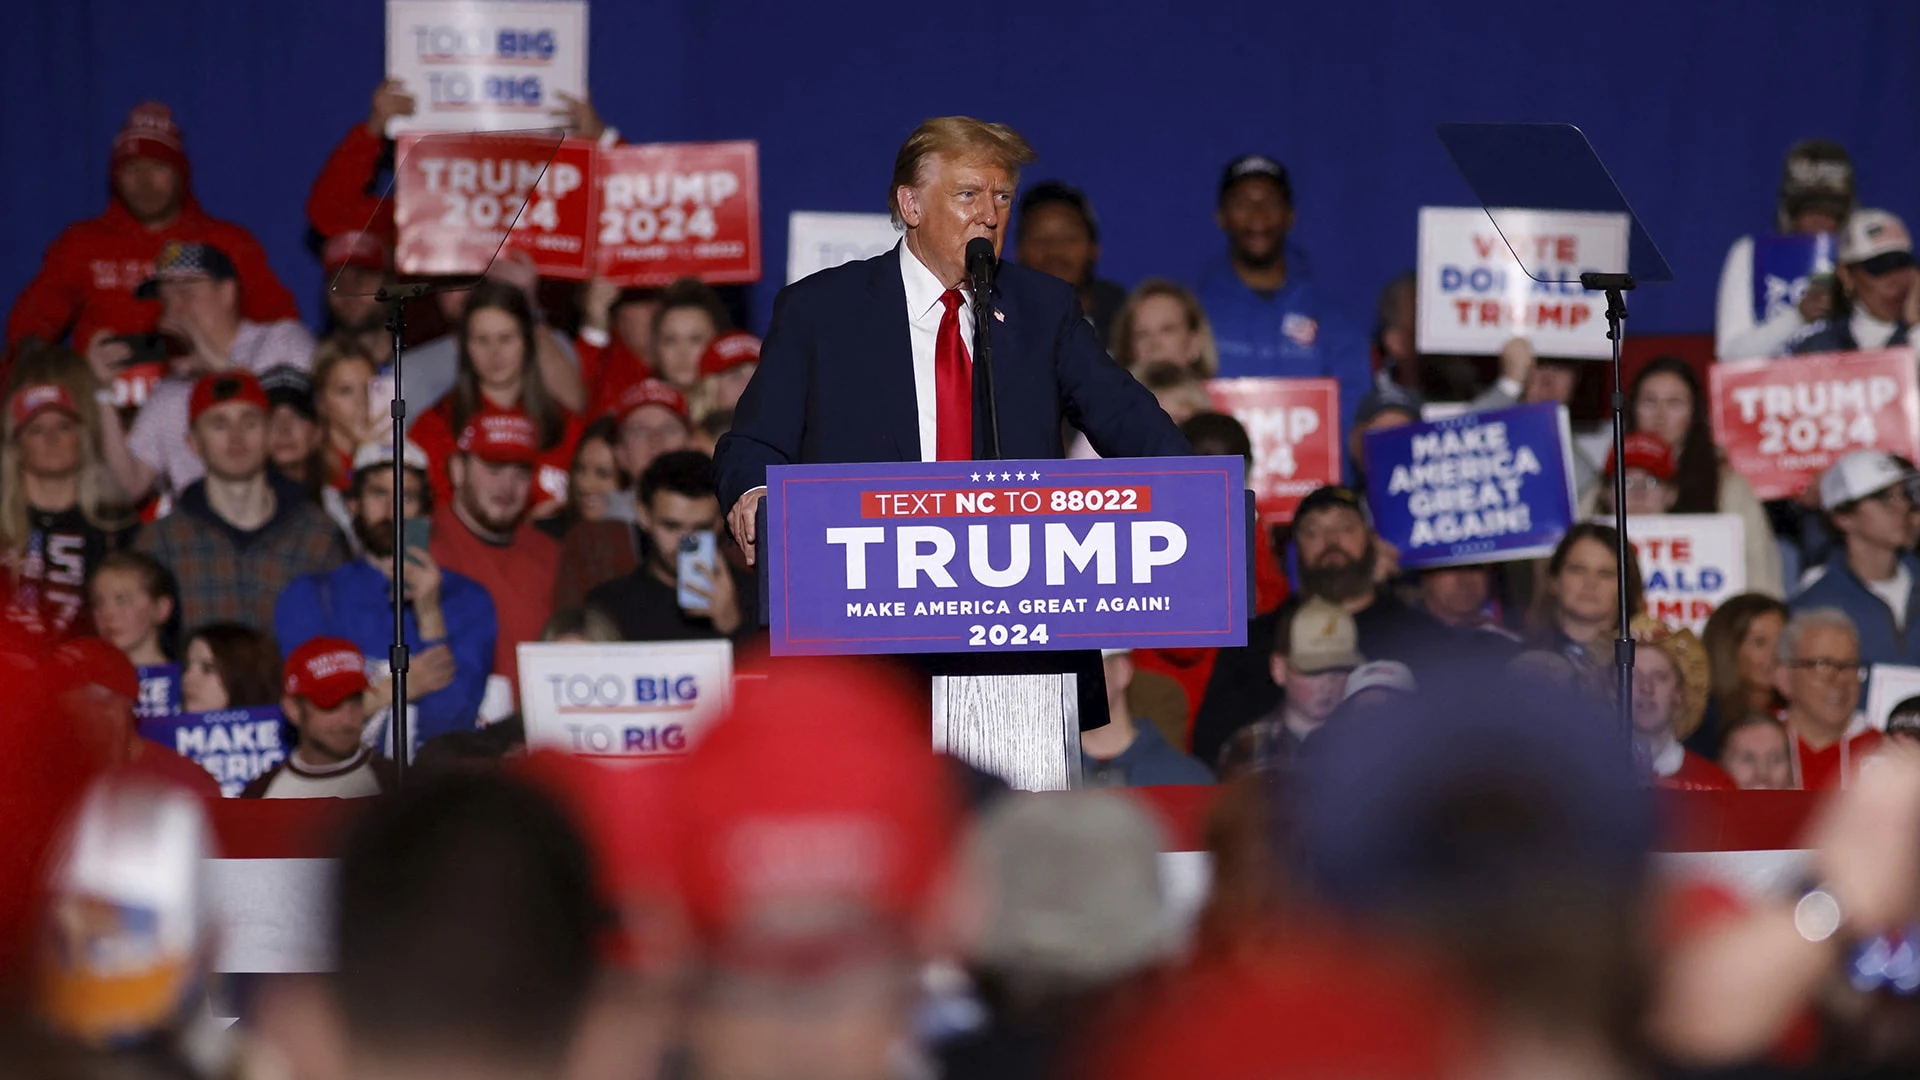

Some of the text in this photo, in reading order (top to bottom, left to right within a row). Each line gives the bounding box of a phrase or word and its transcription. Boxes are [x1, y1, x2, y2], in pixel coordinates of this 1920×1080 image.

[496, 28, 557, 60] BIG
[485, 77, 542, 106] RIG
[417, 158, 583, 198] TRUMP
[597, 170, 739, 209] RUMP
[442, 193, 560, 232] 2024
[599, 203, 718, 245] 2024
[1732, 375, 1897, 423] TRUMP
[1410, 421, 1508, 463] MAKE
[1758, 412, 1877, 455] 2024
[1387, 445, 1543, 496] AMERICA
[876, 489, 1138, 515] TEXT NC TO 88022
[1408, 475, 1524, 520] GREAT
[826, 520, 1188, 590] TRUMP
[847, 596, 1171, 617] MAKE AMERICA GREAT AGAIN!
[968, 623, 1050, 646] 2024
[546, 673, 698, 706] TOO BIG
[176, 718, 282, 758] MAKE
[565, 723, 686, 752] TO RIG
